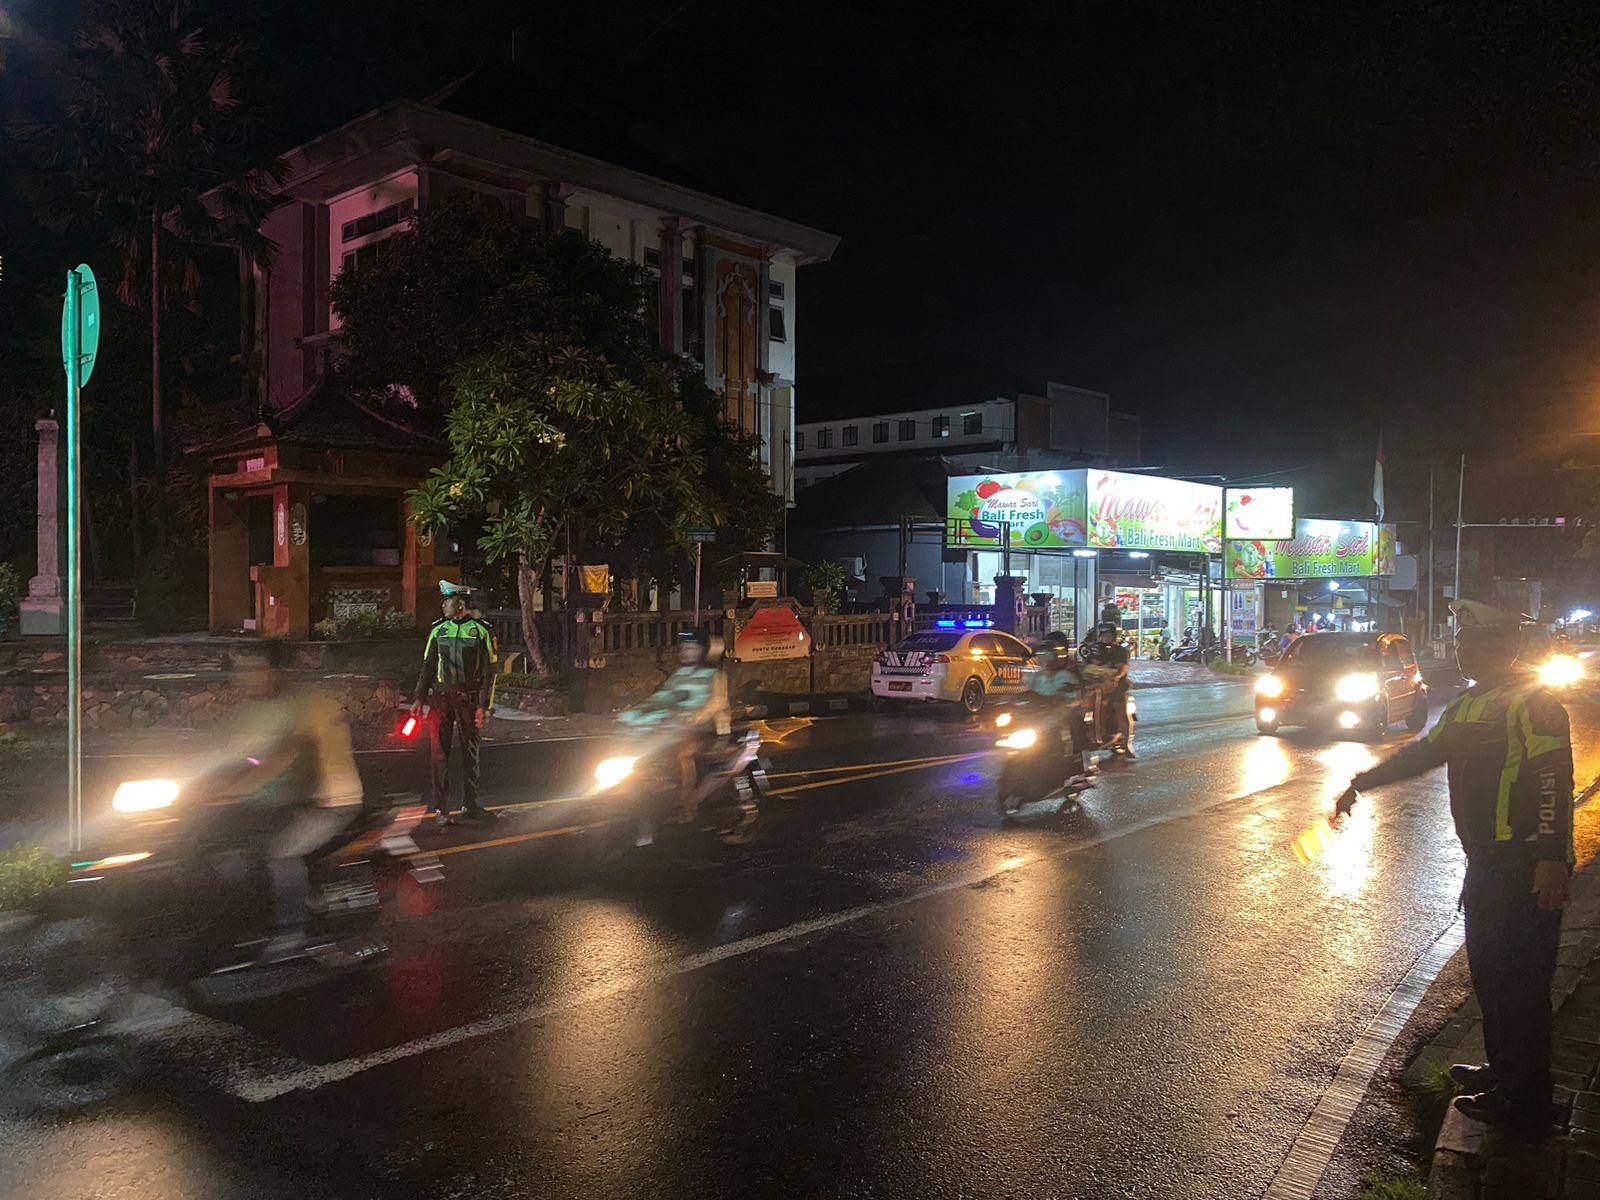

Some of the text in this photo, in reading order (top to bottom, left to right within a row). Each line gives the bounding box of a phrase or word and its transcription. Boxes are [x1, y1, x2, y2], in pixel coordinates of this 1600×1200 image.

[987, 497, 1039, 509] Mawar Sari
[981, 508, 1045, 521] Bali Fresh
[1127, 527, 1201, 549] Bali Fresh Mart
[1335, 527, 1370, 558] Sari
[1292, 560, 1361, 575] Bali Fresh Mart
[997, 667, 1020, 679] POLISI
[1539, 773, 1556, 834] POLISI
